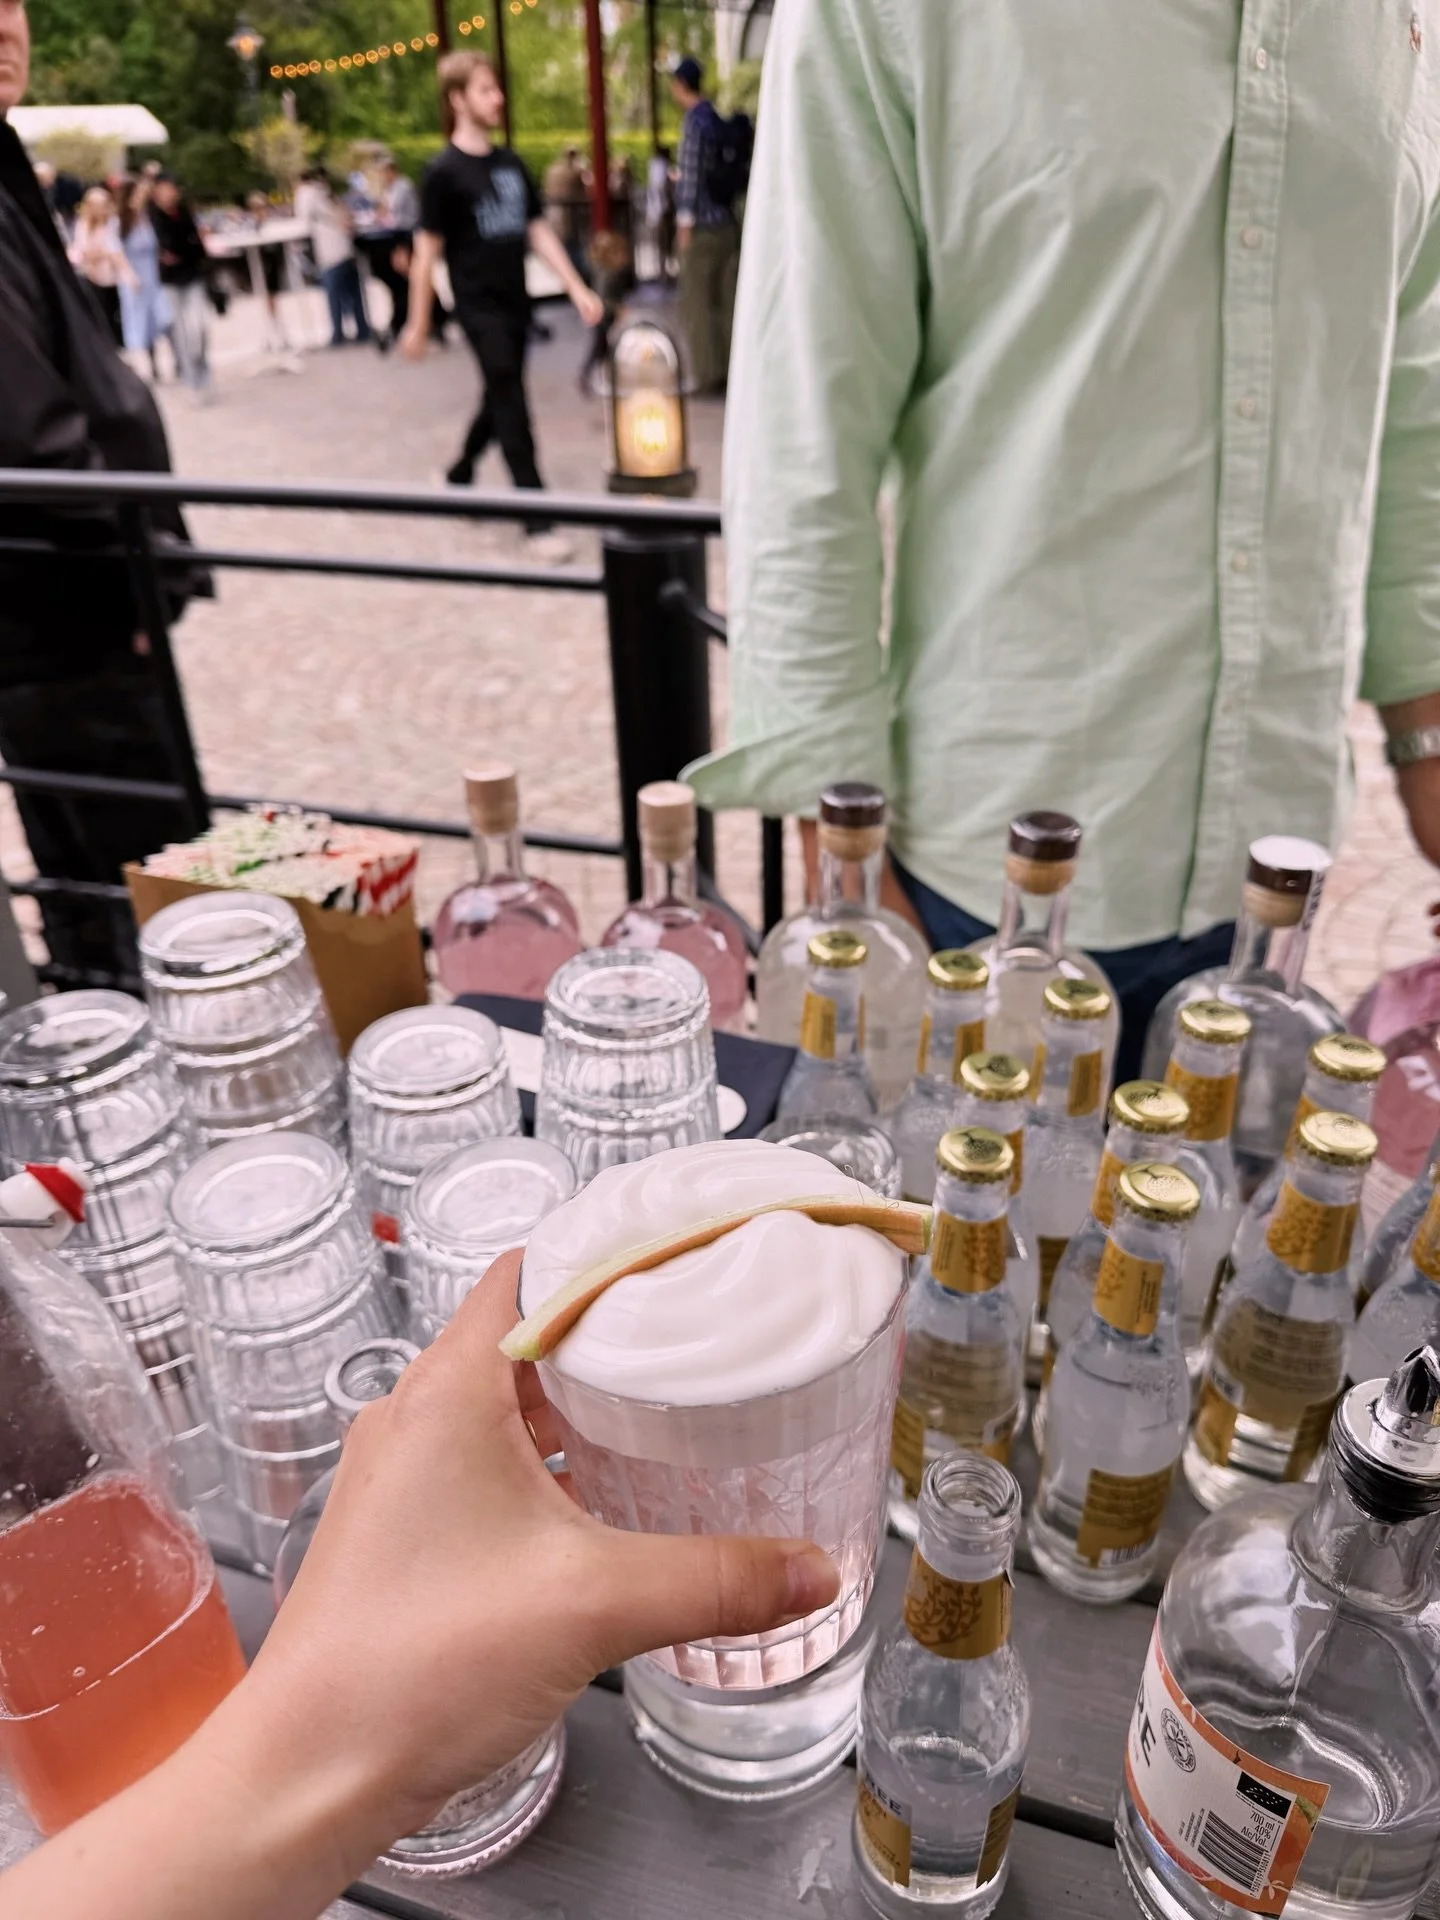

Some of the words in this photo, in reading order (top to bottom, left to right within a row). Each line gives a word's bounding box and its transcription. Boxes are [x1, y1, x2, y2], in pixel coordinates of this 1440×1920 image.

[1250, 1810, 1265, 1826] 700
[1264, 1822, 1275, 1831] ml
[1240, 1826, 1267, 1848] Alc/Vol.
[1254, 1825, 1271, 1840] 40%
